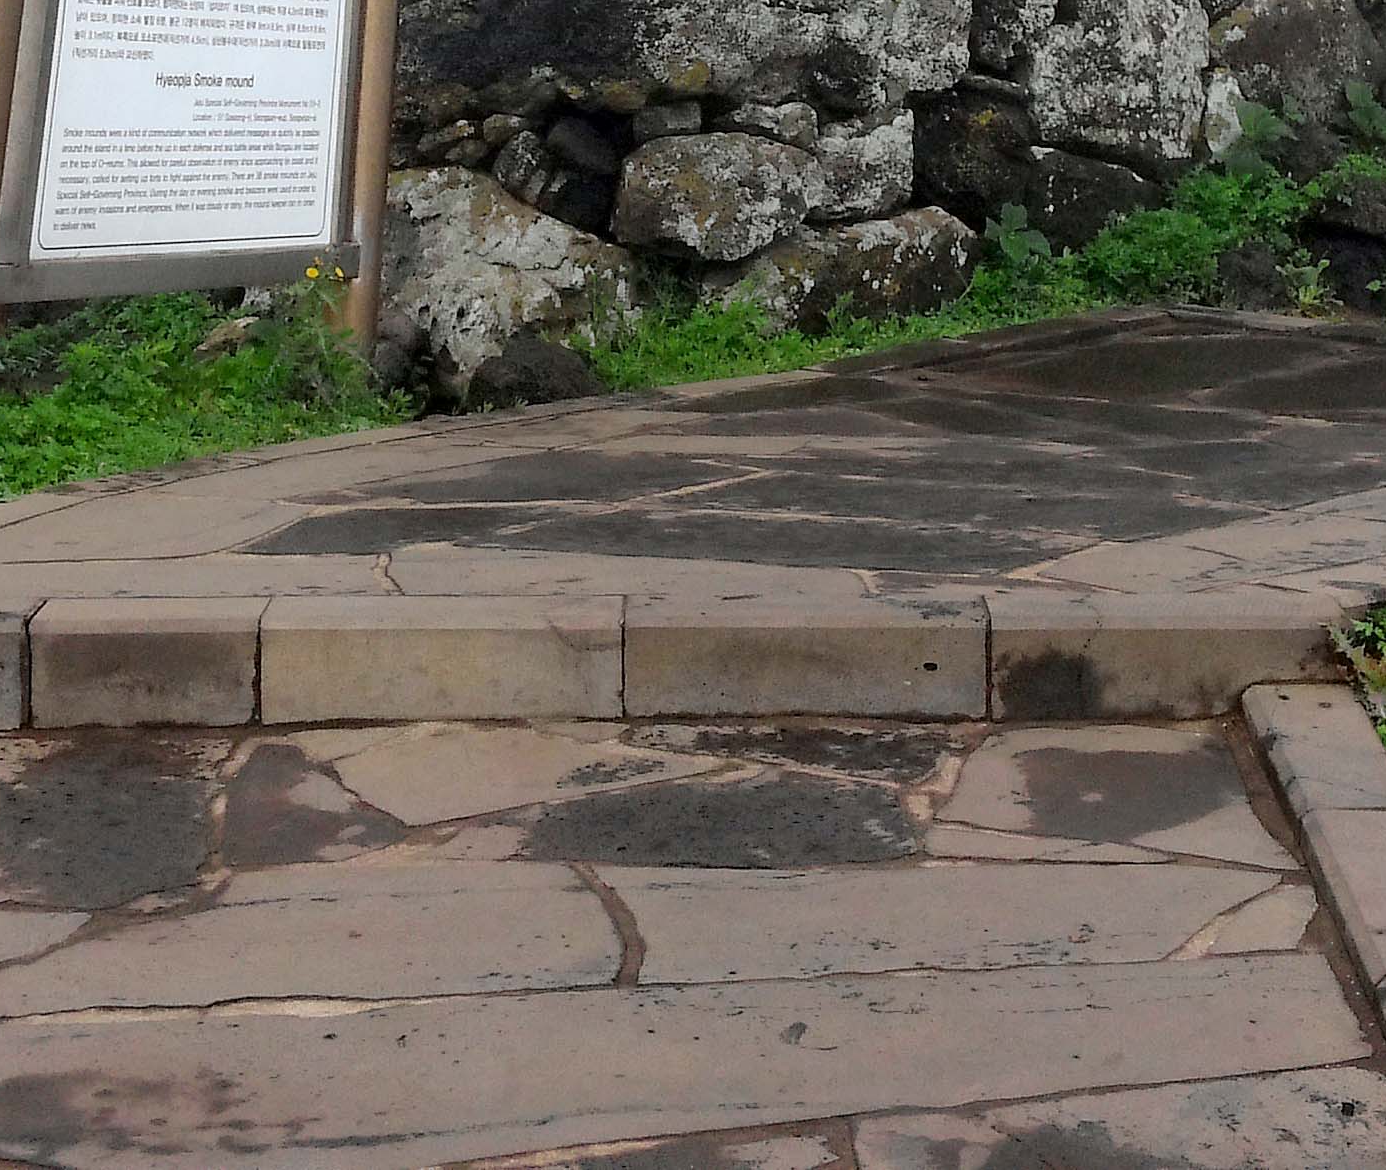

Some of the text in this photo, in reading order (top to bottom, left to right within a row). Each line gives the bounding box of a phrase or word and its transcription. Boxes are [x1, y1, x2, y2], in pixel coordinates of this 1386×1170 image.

[156, 73, 254, 88] Hyeopja Smoke mound
